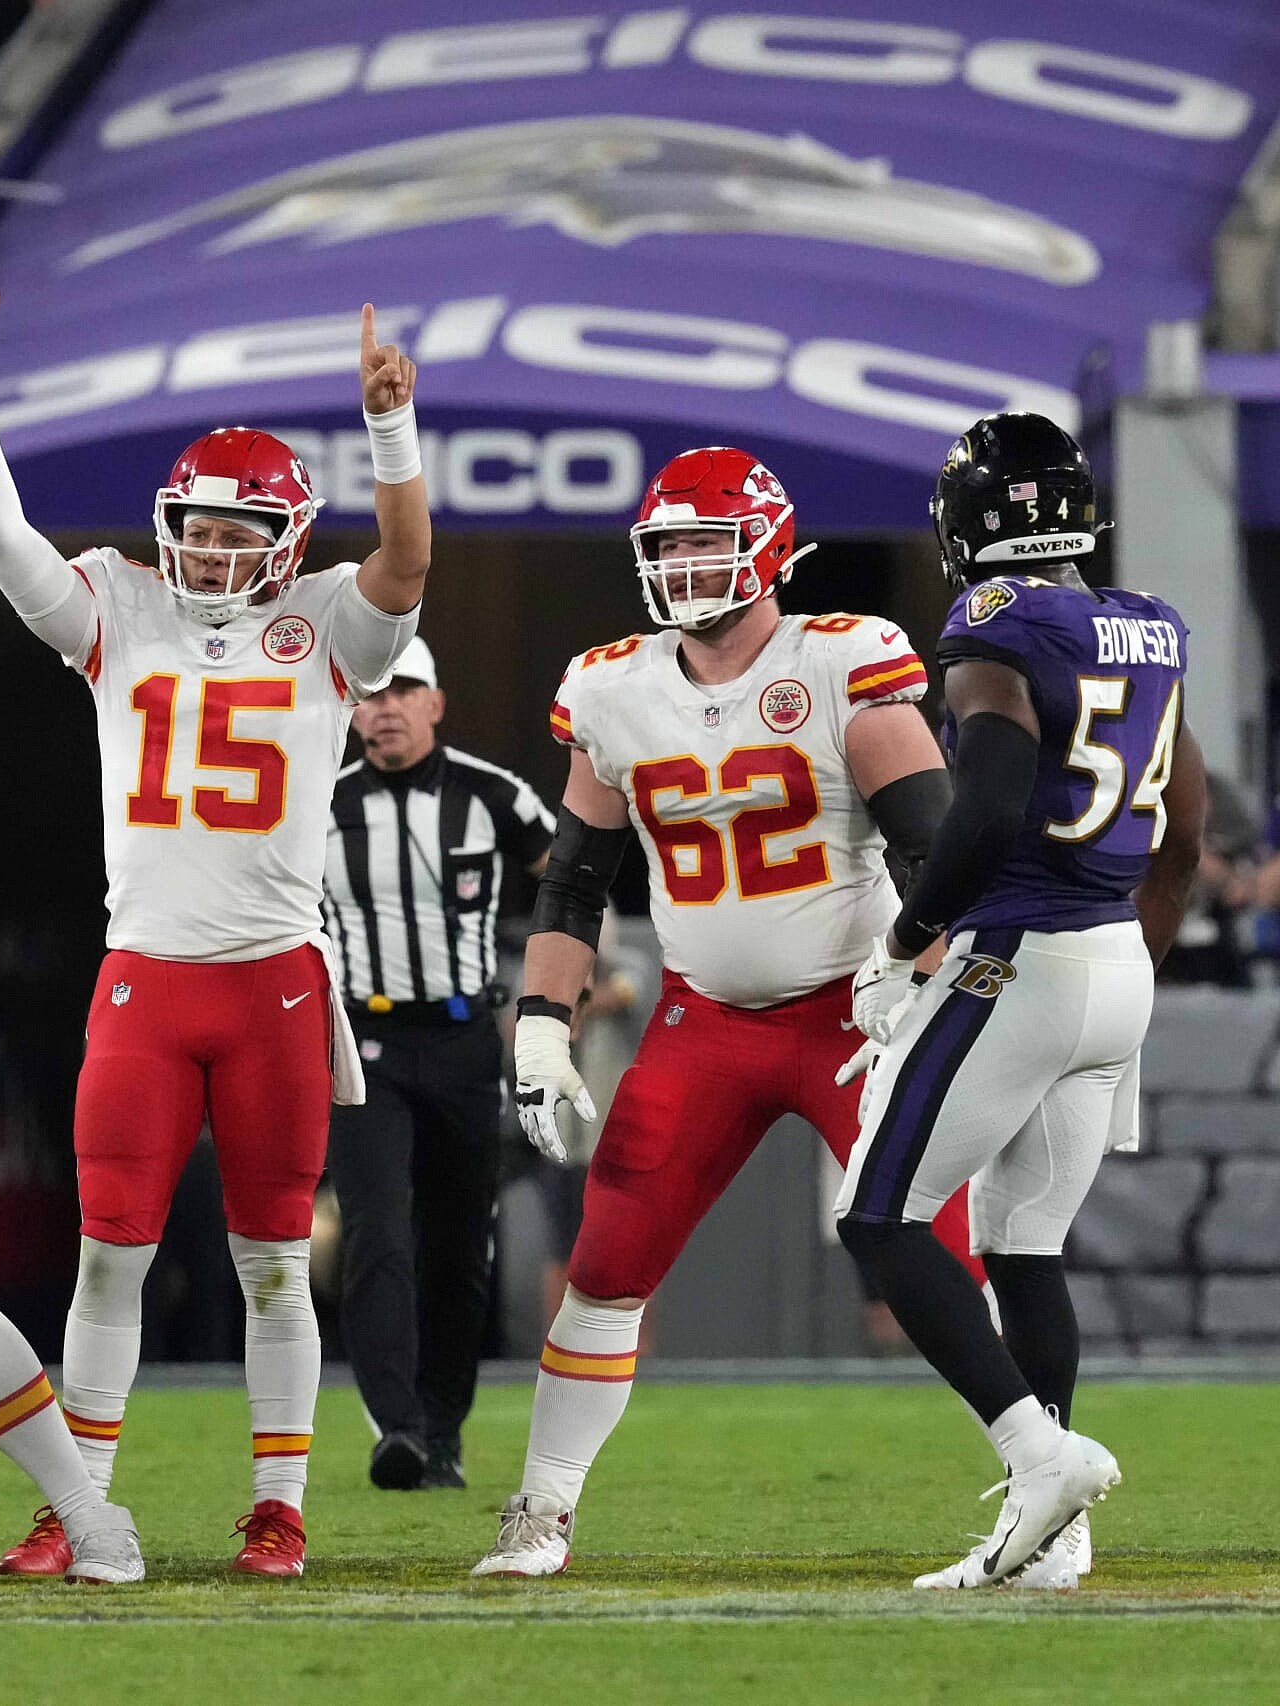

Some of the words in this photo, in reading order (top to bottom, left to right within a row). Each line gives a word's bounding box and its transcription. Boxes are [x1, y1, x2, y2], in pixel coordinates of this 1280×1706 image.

[100, 11, 1253, 148] GEICO
[1010, 538, 1083, 555] RAVENS
[1092, 616, 1181, 668] BOWSER
[126, 671, 297, 835] 15
[630, 742, 834, 906] 62
[1042, 675, 1181, 855] 54
